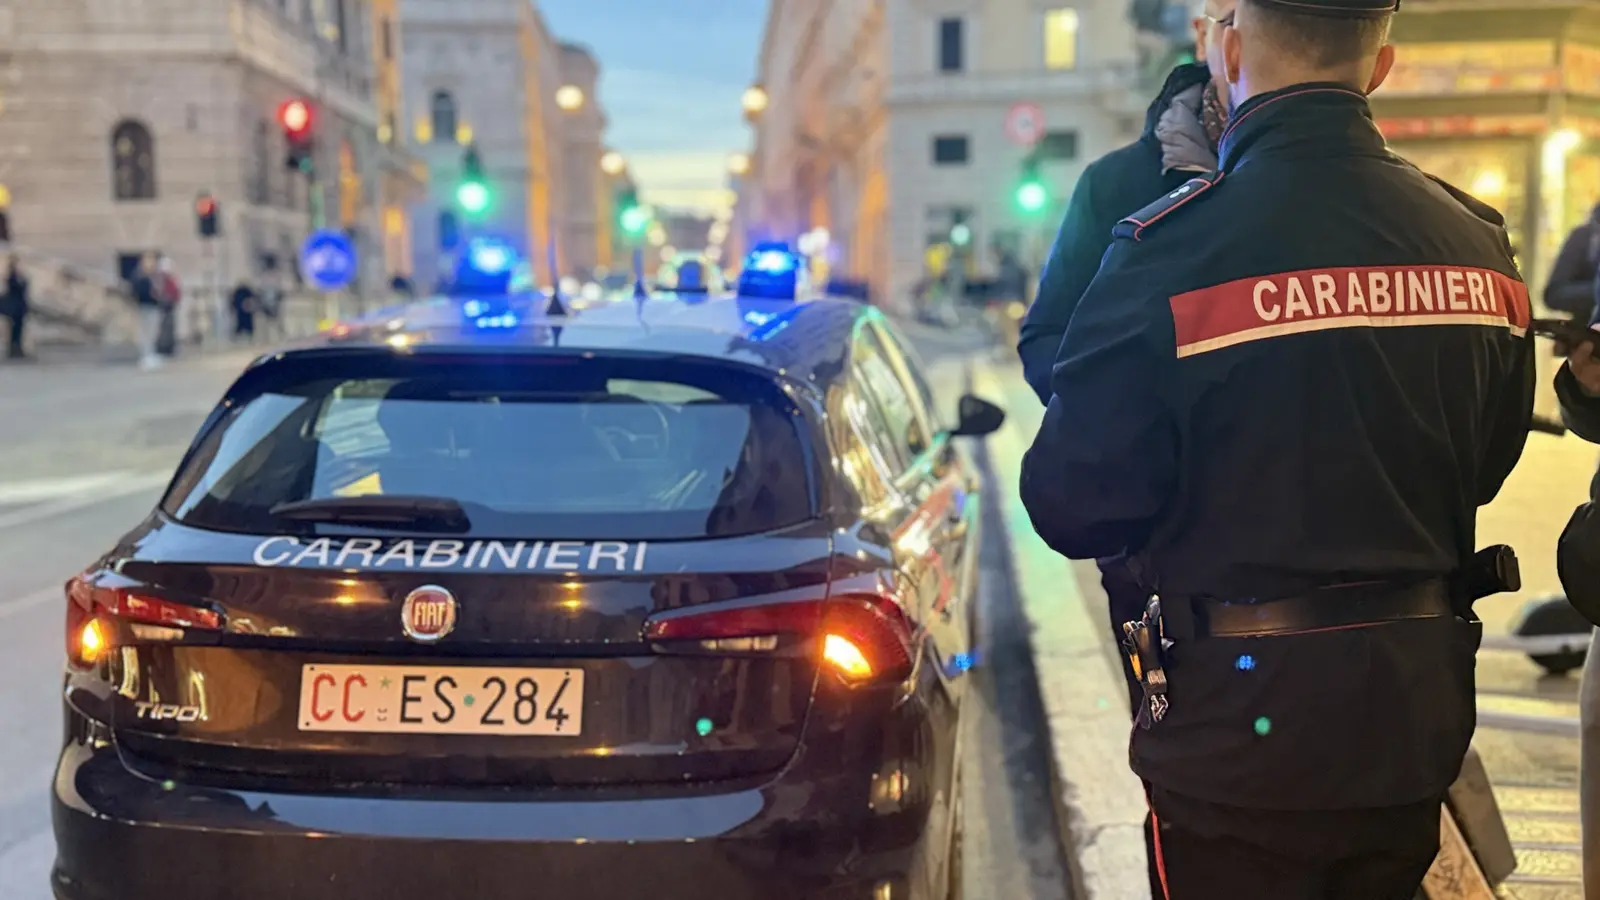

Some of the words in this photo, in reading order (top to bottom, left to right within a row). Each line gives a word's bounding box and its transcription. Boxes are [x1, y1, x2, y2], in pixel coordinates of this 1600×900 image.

[1253, 271, 1496, 320] CARABINIERI
[253, 536, 647, 571] CARABINIERI
[413, 601, 446, 628] FIAT
[135, 702, 200, 721] TIPO
[311, 673, 367, 722] CC
[400, 675, 457, 723] ES
[480, 677, 570, 727] 284
